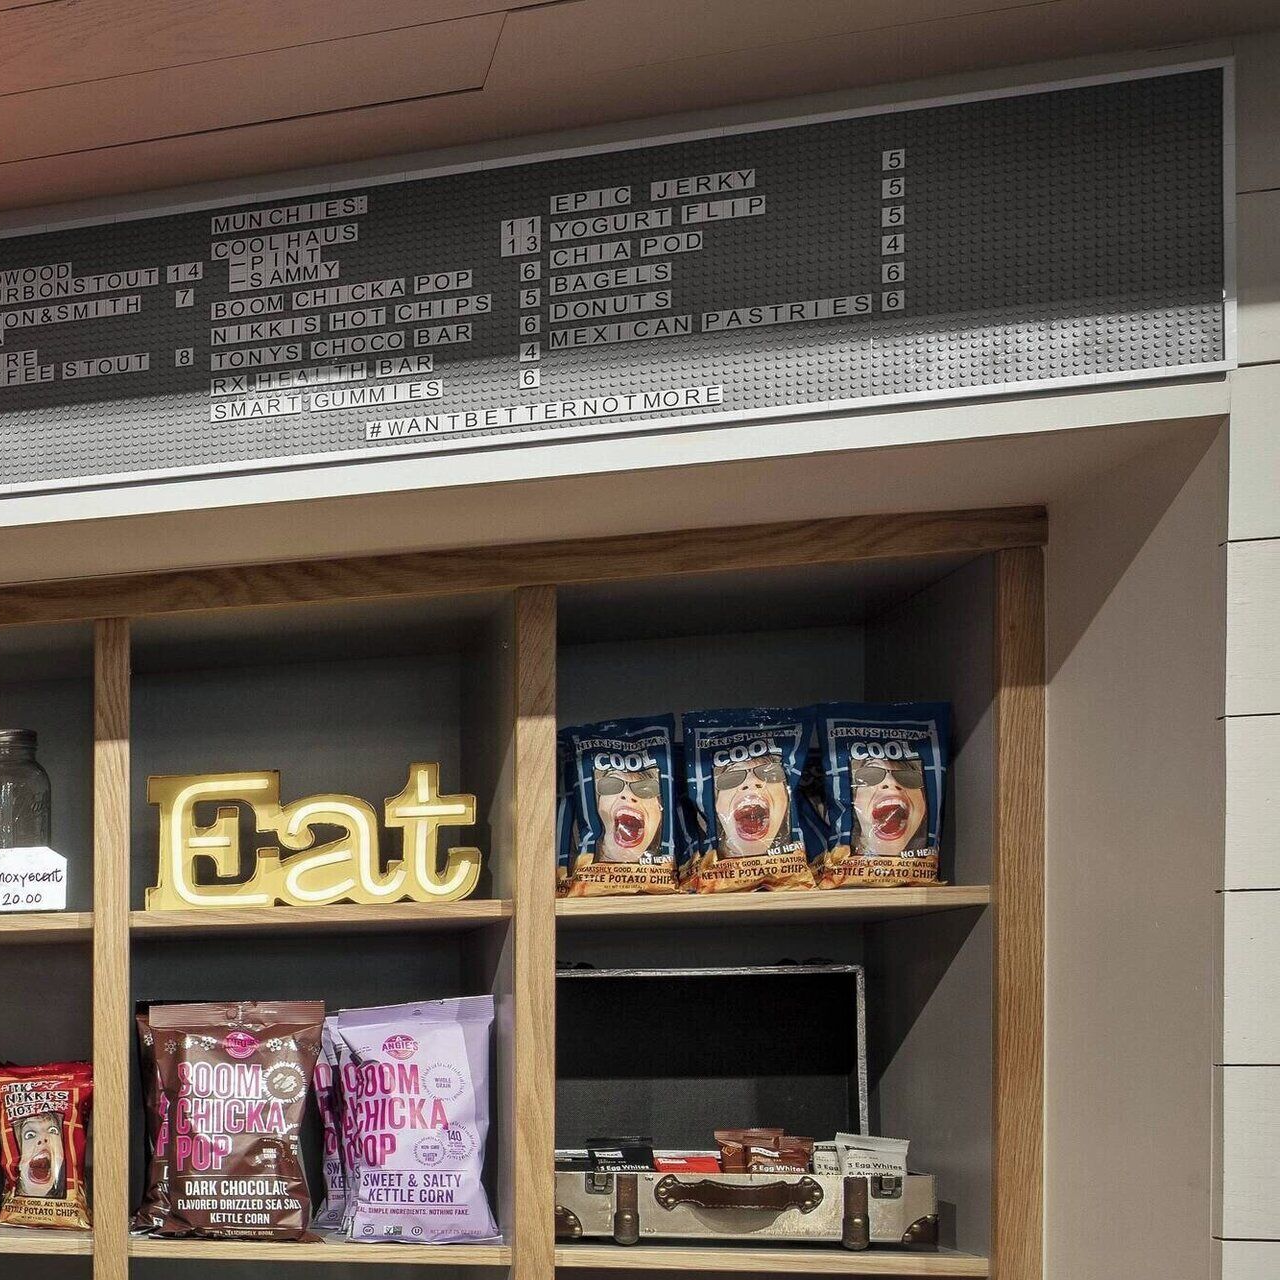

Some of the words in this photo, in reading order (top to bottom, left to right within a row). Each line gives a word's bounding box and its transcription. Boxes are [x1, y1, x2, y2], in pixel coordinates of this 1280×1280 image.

[556, 187, 630, 212] EPIC
[656, 170, 753, 199] JERKY
[214, 197, 365, 233] MUNCHIES:
[554, 208, 670, 239] YOGURT
[686, 197, 764, 222] FLIP
[553, 242, 630, 266] CHIA
[644, 232, 701, 255] POD
[214, 296, 284, 318] BOOM
[294, 280, 405, 309] CHICKA
[416, 272, 471, 292] POP
[554, 264, 669, 294] BAGELS
[213, 317, 317, 344] NIKKIS
[331, 310, 384, 330] HOT
[398, 296, 489, 320] CHIPS
[551, 316, 690, 348] MEXICAN
[706, 295, 870, 328] PASTRIES
[553, 291, 670, 320] DONUTS
[213, 346, 299, 368] TONYS
[313, 333, 402, 358] CHOCO
[416, 325, 471, 345] BAR
[213, 378, 246, 393] RX
[257, 363, 365, 390] HEALTH
[380, 354, 432, 375] BAR
[214, 397, 299, 419] SMART
[315, 381, 440, 409] GUMMIES
[369, 386, 721, 437] #WANTBETTERNOTMORE
[713, 740, 783, 767] COOL
[850, 739, 920, 761] COOL
[146, 761, 482, 910] Eat
[2, 892, 43, 906] 20.00
[176, 1100, 284, 1134] CHICKA
[176, 1134, 232, 1172] POP
[855, 1162, 869, 1172] Egg
[871, 1163, 903, 1171] Whites
[185, 1180, 217, 1197] DARK
[220, 1180, 288, 1197] CHOCOLATE
[363, 1173, 403, 1187] SWEET
[408, 1174, 418, 1187] &
[423, 1174, 462, 1188] SALTY
[368, 1189, 416, 1203] KETTLE
[419, 1190, 454, 1203] CORN
[178, 1199, 218, 1210] FLAVORED
[220, 1199, 262, 1210] DRIZZLED
[265, 1199, 282, 1210] SEA
[210, 1212, 243, 1224] KETTLE
[245, 1213, 270, 1225] CORN
